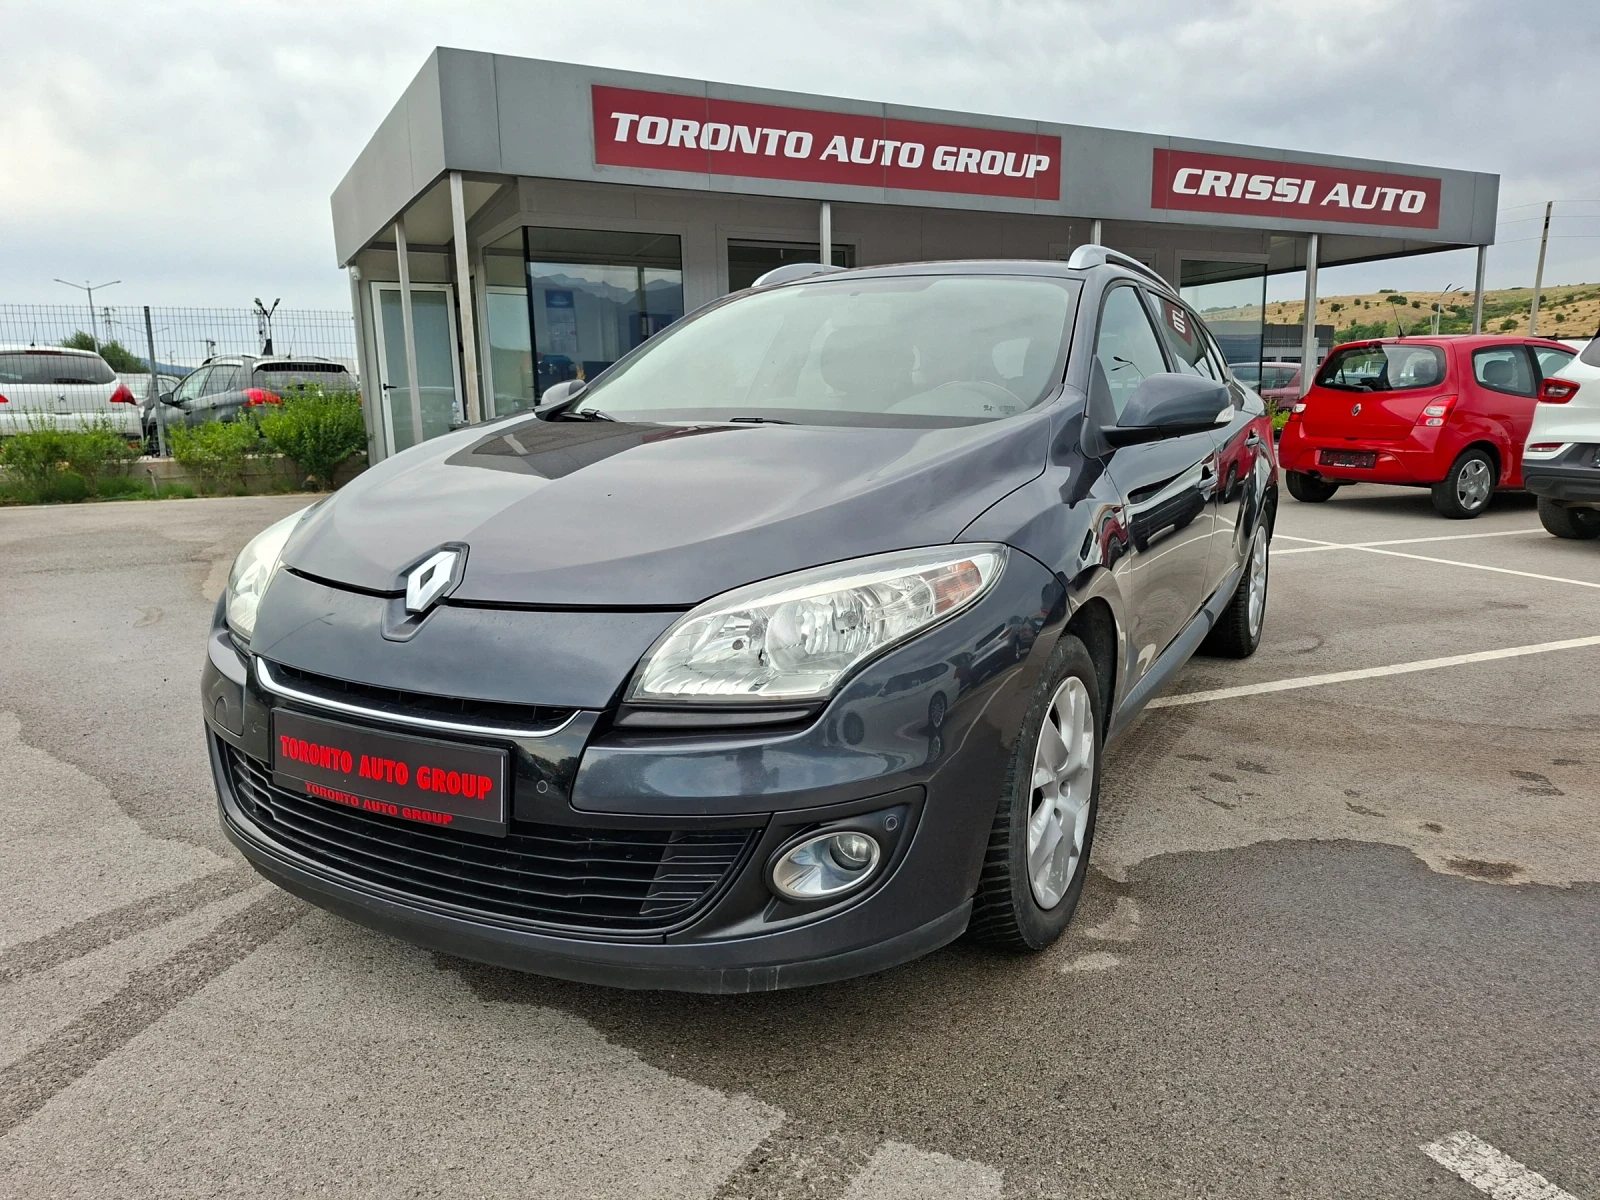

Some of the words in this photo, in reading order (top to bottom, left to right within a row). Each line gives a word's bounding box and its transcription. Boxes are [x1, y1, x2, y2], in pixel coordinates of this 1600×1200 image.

[610, 111, 814, 159] TORONTO
[819, 135, 925, 169] AUTO
[931, 145, 1051, 179] GROUP
[1172, 167, 1317, 205] CRISSI
[1320, 182, 1427, 214] AUTO
[279, 735, 353, 774] TORONTO
[358, 754, 409, 786] AUTO
[416, 765, 493, 800] GROUP
[304, 781, 360, 808] TORONTO
[362, 799, 399, 817] AUTO
[401, 806, 454, 826] GROUP
